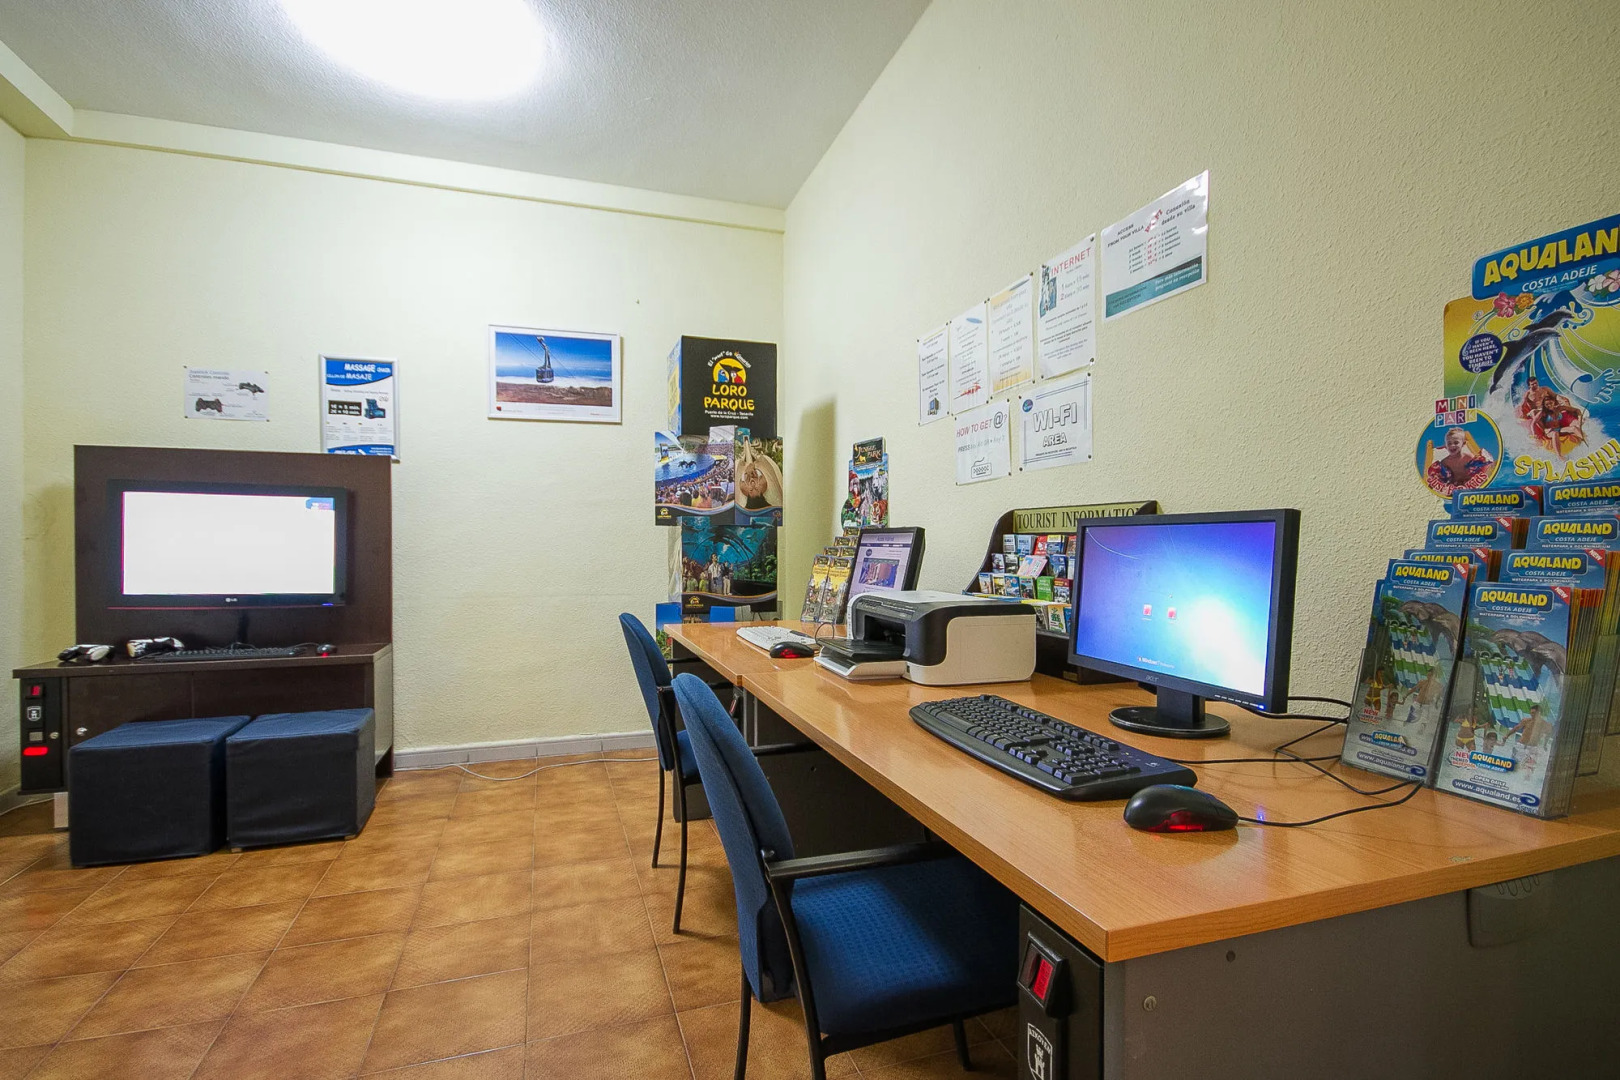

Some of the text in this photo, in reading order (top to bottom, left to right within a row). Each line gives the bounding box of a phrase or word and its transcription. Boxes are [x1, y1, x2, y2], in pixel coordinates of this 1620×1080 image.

[1131, 225, 1144, 236] VILLA
[1051, 247, 1092, 277] INTERNET
[1484, 228, 1620, 287] AQUALAN
[1522, 275, 1558, 292] COSTA
[1560, 264, 1598, 283] ADEJE
[344, 363, 376, 373] MASSAGE
[346, 372, 373, 381] MASAJE
[712, 384, 748, 397] LORO
[704, 396, 755, 412] PARQUE
[1436, 395, 1474, 413] MINI
[1033, 402, 1078, 433] WI-FI
[1436, 410, 1475, 426] PARK
[956, 425, 970, 438] HOW
[971, 422, 980, 435] TO
[980, 418, 993, 431] GET
[1042, 432, 1068, 448] AREA
[958, 443, 971, 453] PRESS
[1462, 494, 1520, 505] AQUALAND
[1554, 486, 1620, 500] AQUALAND
[1016, 508, 1141, 529] TOURIST INFORMATIO
[1436, 524, 1493, 536] AQUALAND
[1543, 522, 1613, 535] AQUALAND
[1513, 556, 1582, 570] AQUALAND
[1396, 566, 1450, 580] AQUALAND
[1480, 590, 1548, 607] AQUALAND
[1358, 752, 1412, 772] www.aqualand.e
[1454, 751, 1470, 759] NE
[1472, 754, 1513, 769] AQUALAND
[1454, 781, 1521, 803] www.aqualand.es
